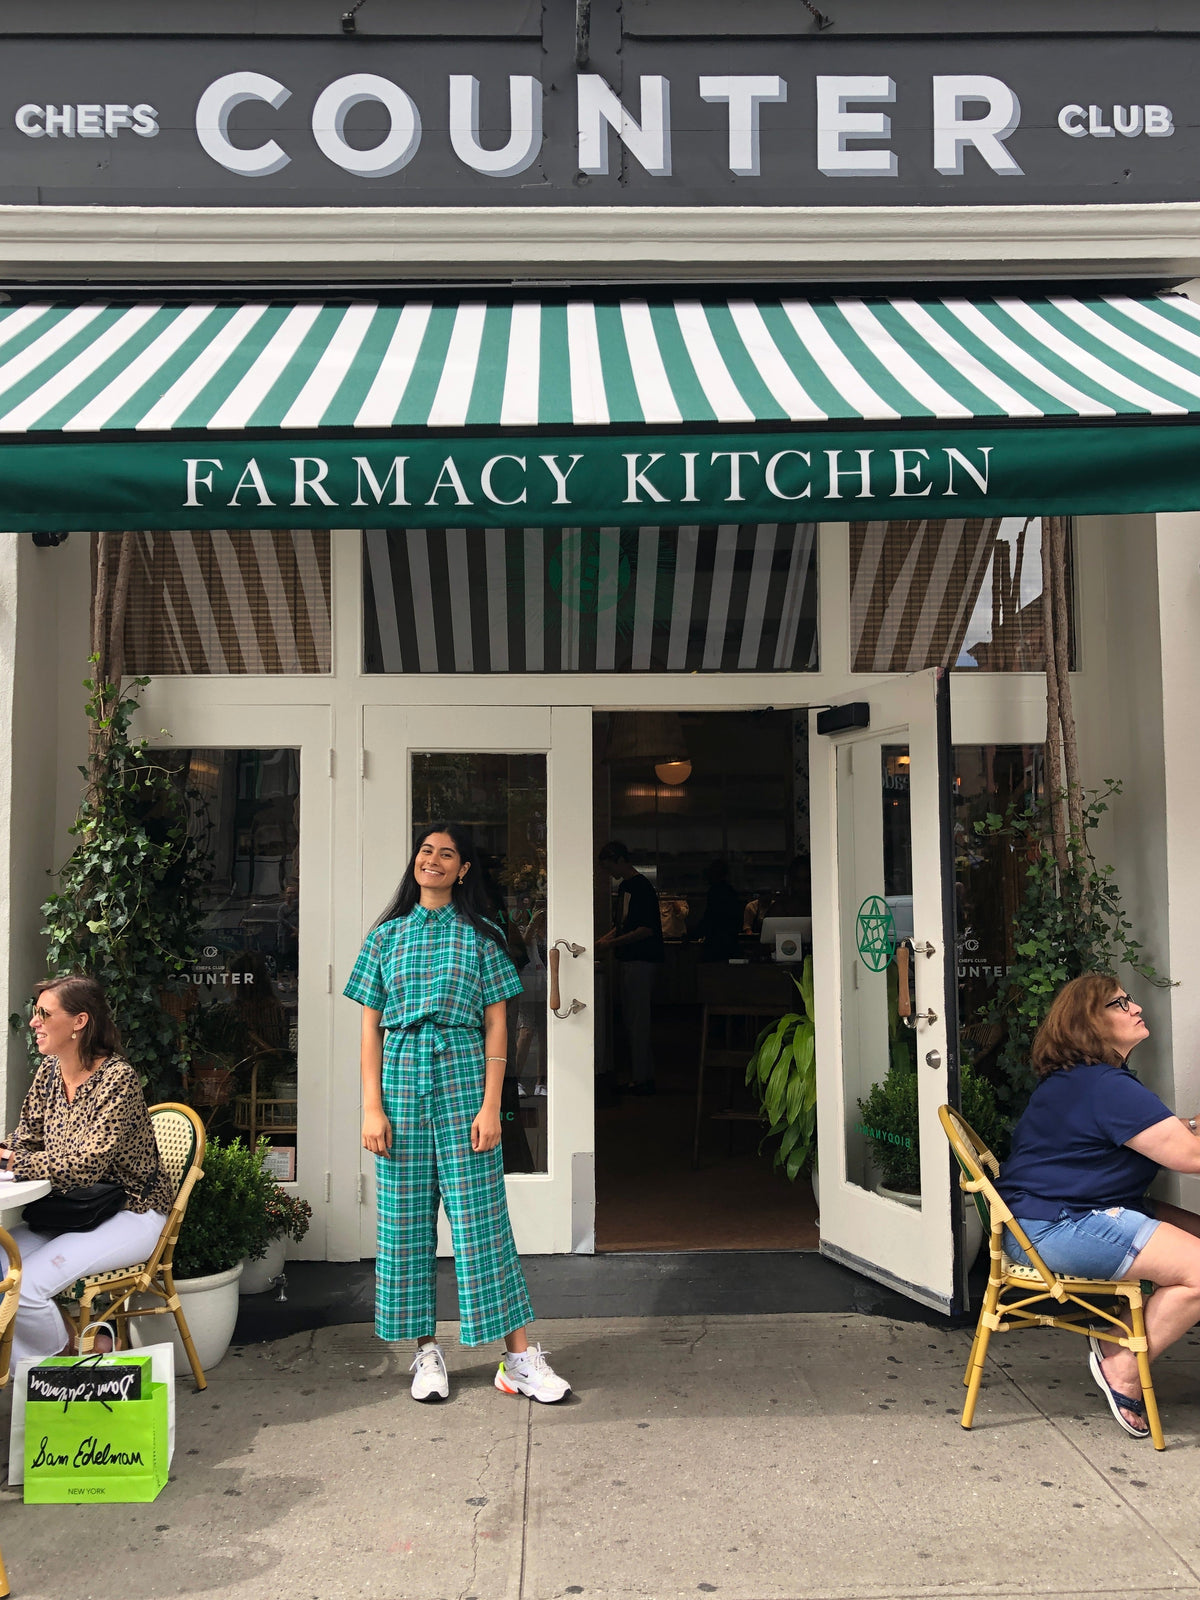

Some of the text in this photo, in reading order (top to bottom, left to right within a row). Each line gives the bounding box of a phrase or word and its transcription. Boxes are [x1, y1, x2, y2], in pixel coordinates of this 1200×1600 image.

[15, 70, 1175, 178] CHEFS COUNTER CLUB
[182, 446, 995, 507] FARMACY KITCHEN
[957, 966, 1012, 978] UNTE
[31, 1435, 144, 1469] Sam Edelman
